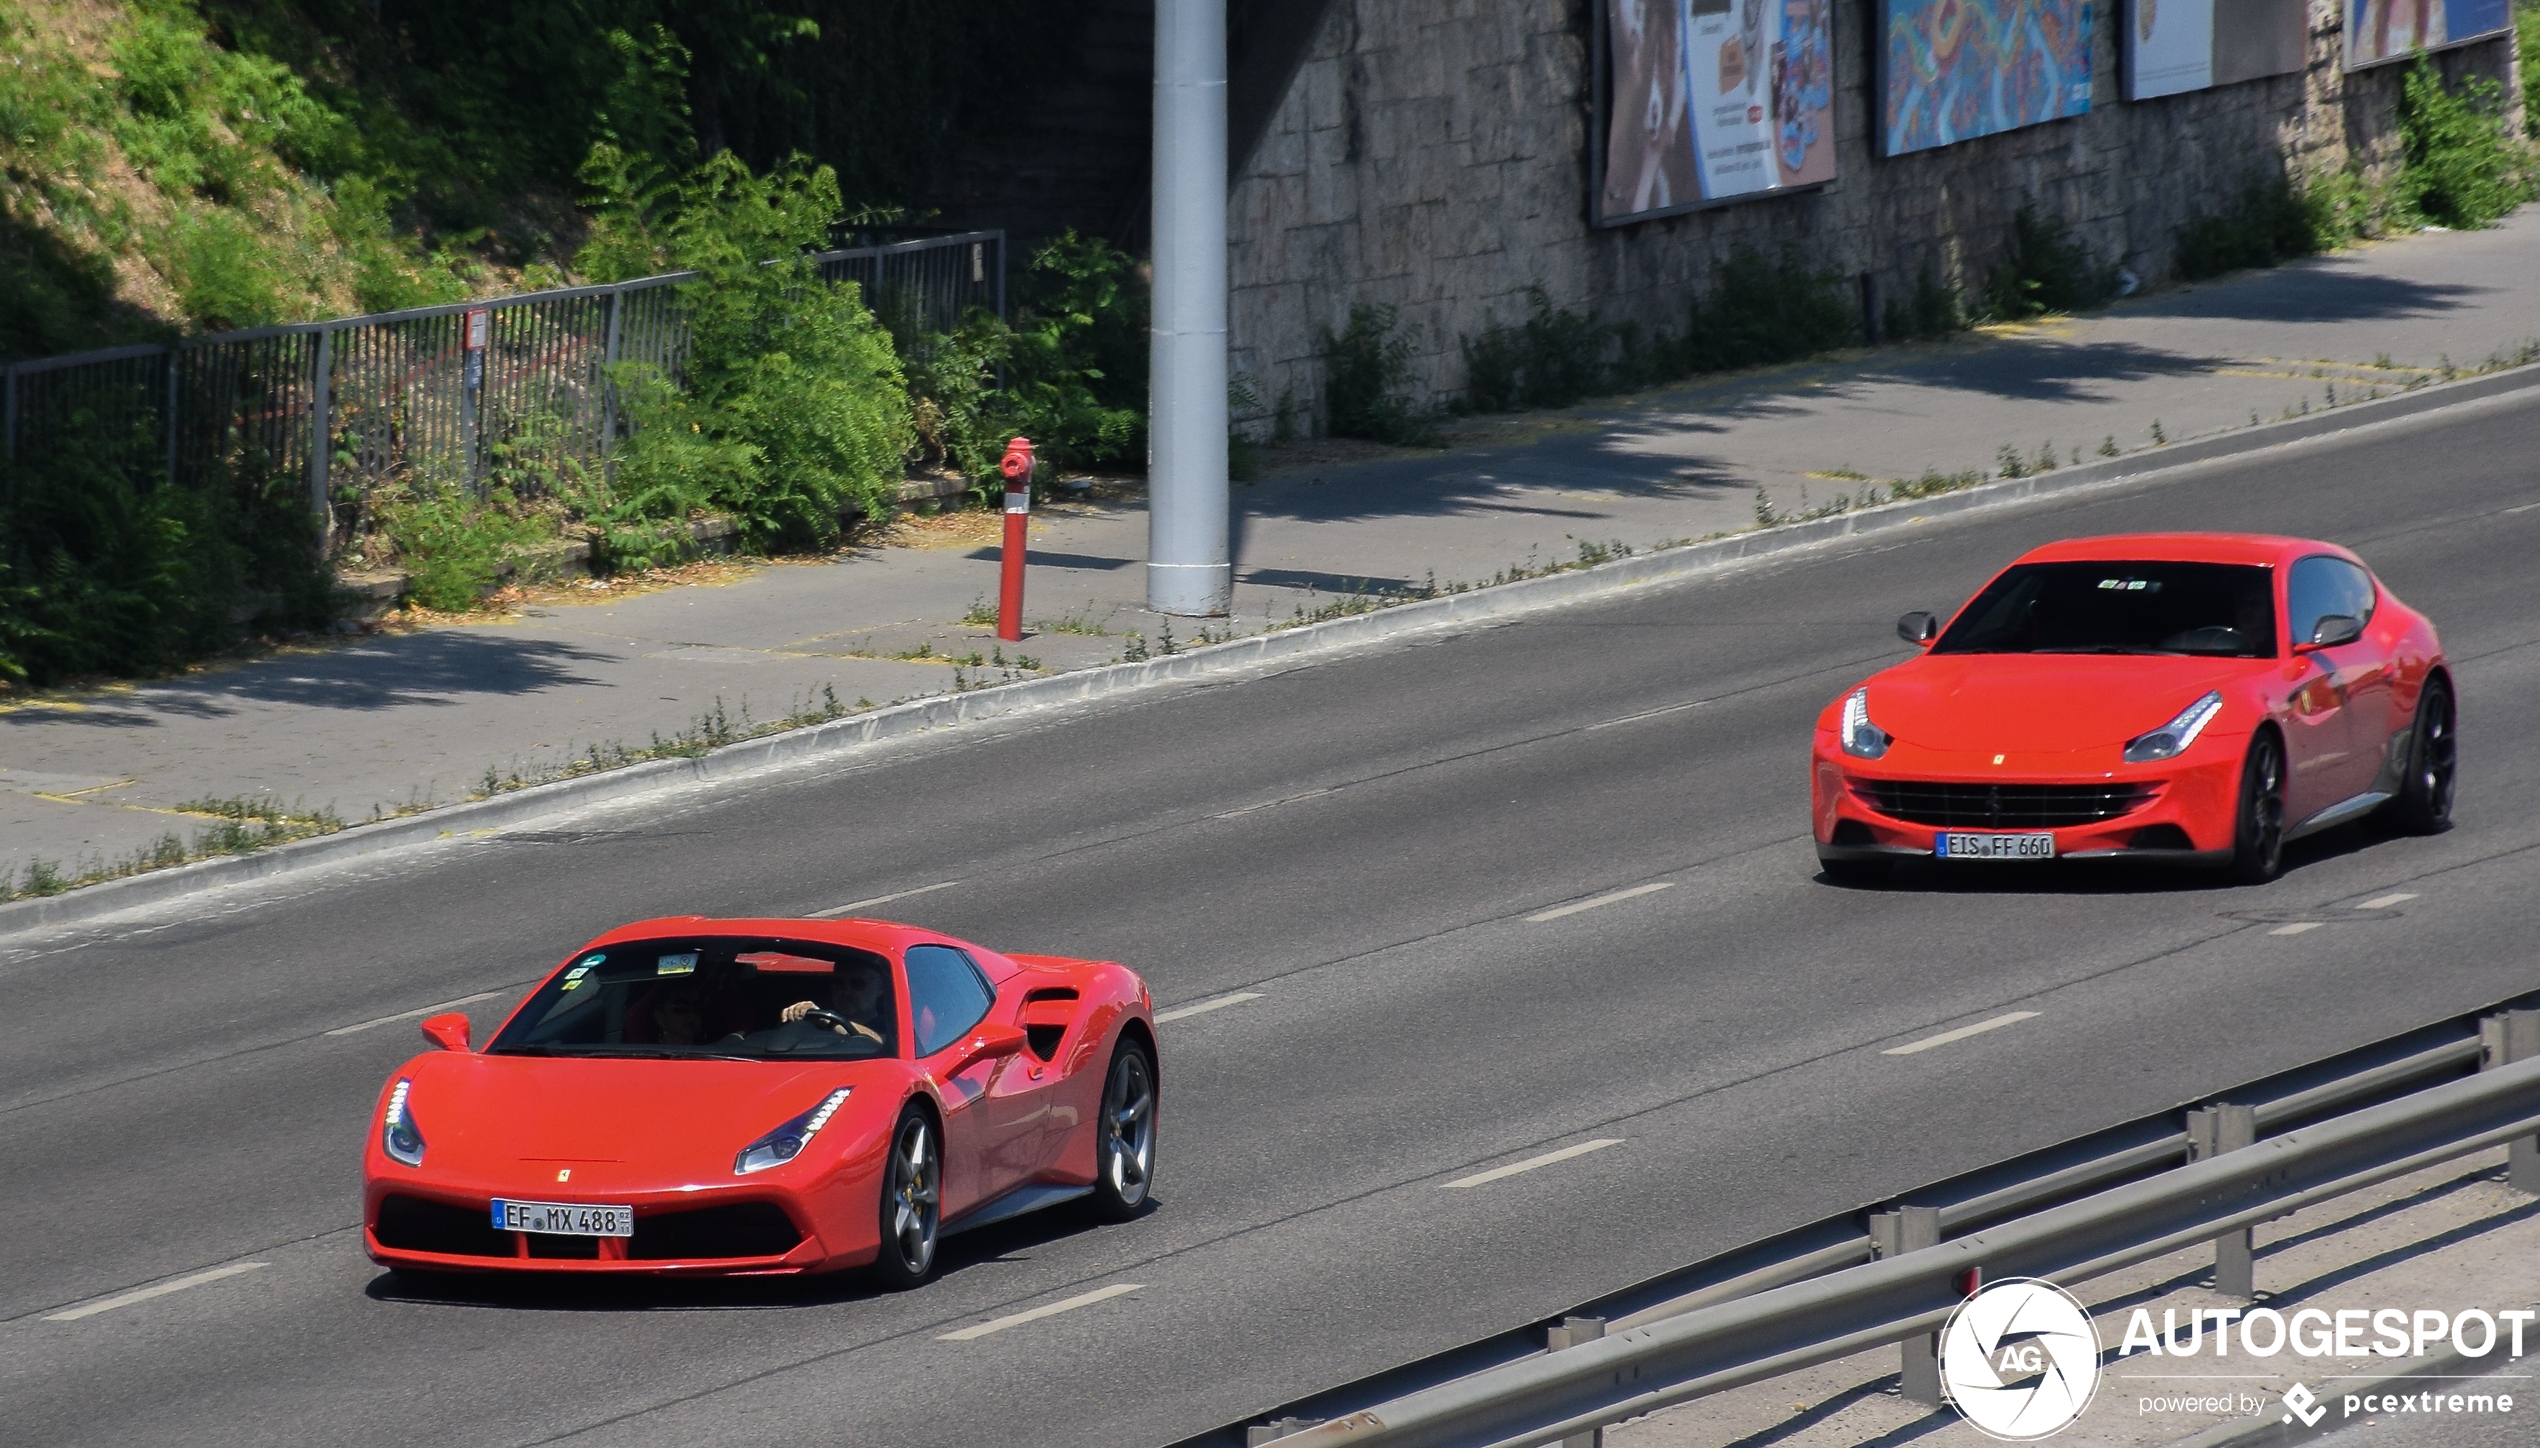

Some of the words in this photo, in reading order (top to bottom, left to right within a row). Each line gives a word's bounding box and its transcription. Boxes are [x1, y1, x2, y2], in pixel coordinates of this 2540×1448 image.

[1948, 836, 1979, 855] EIS
[1992, 837, 2013, 856] FF
[2019, 837, 2050, 855] 660
[506, 1204, 531, 1228] EF
[546, 1207, 574, 1232] MX
[578, 1210, 617, 1233] 488
